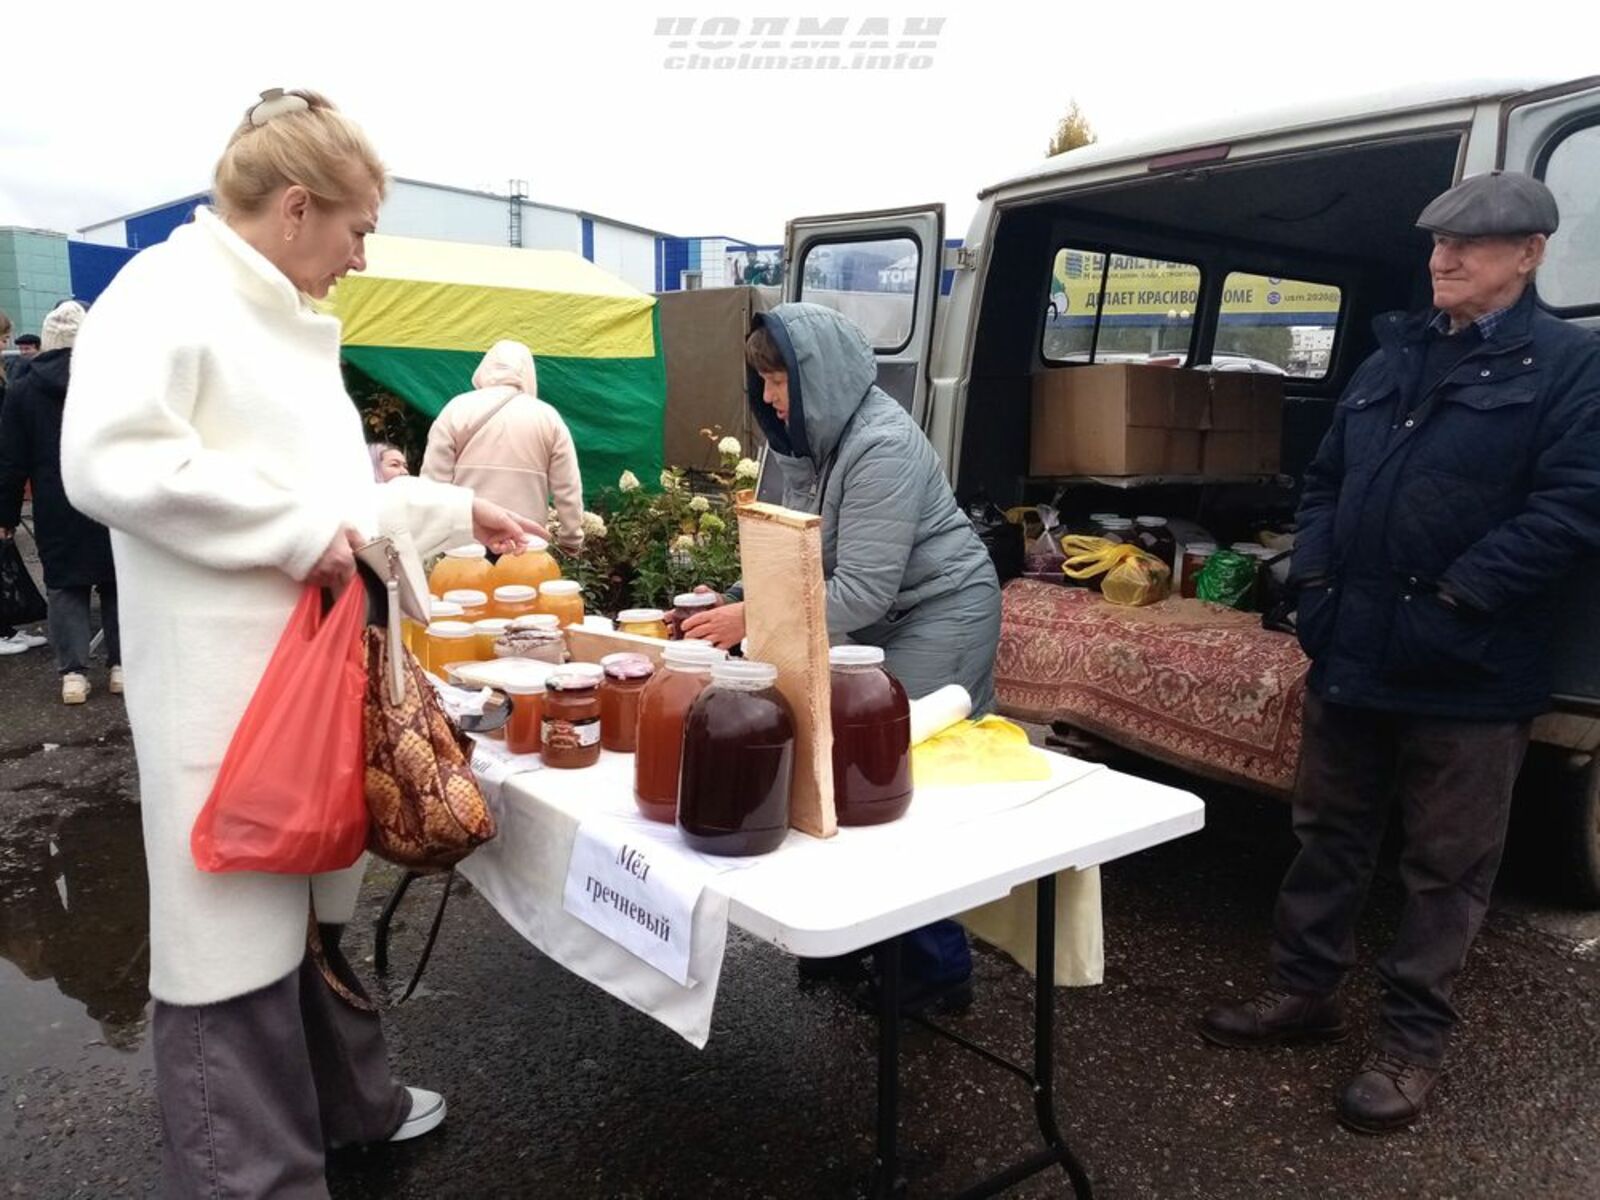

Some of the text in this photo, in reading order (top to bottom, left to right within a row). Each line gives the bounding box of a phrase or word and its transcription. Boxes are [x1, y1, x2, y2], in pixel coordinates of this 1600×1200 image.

[1085, 289, 1253, 308] ДЛАЕТ КРАСИВО ОМЕ
[616, 844, 650, 883] Мёд
[586, 876, 671, 942] гречневый
